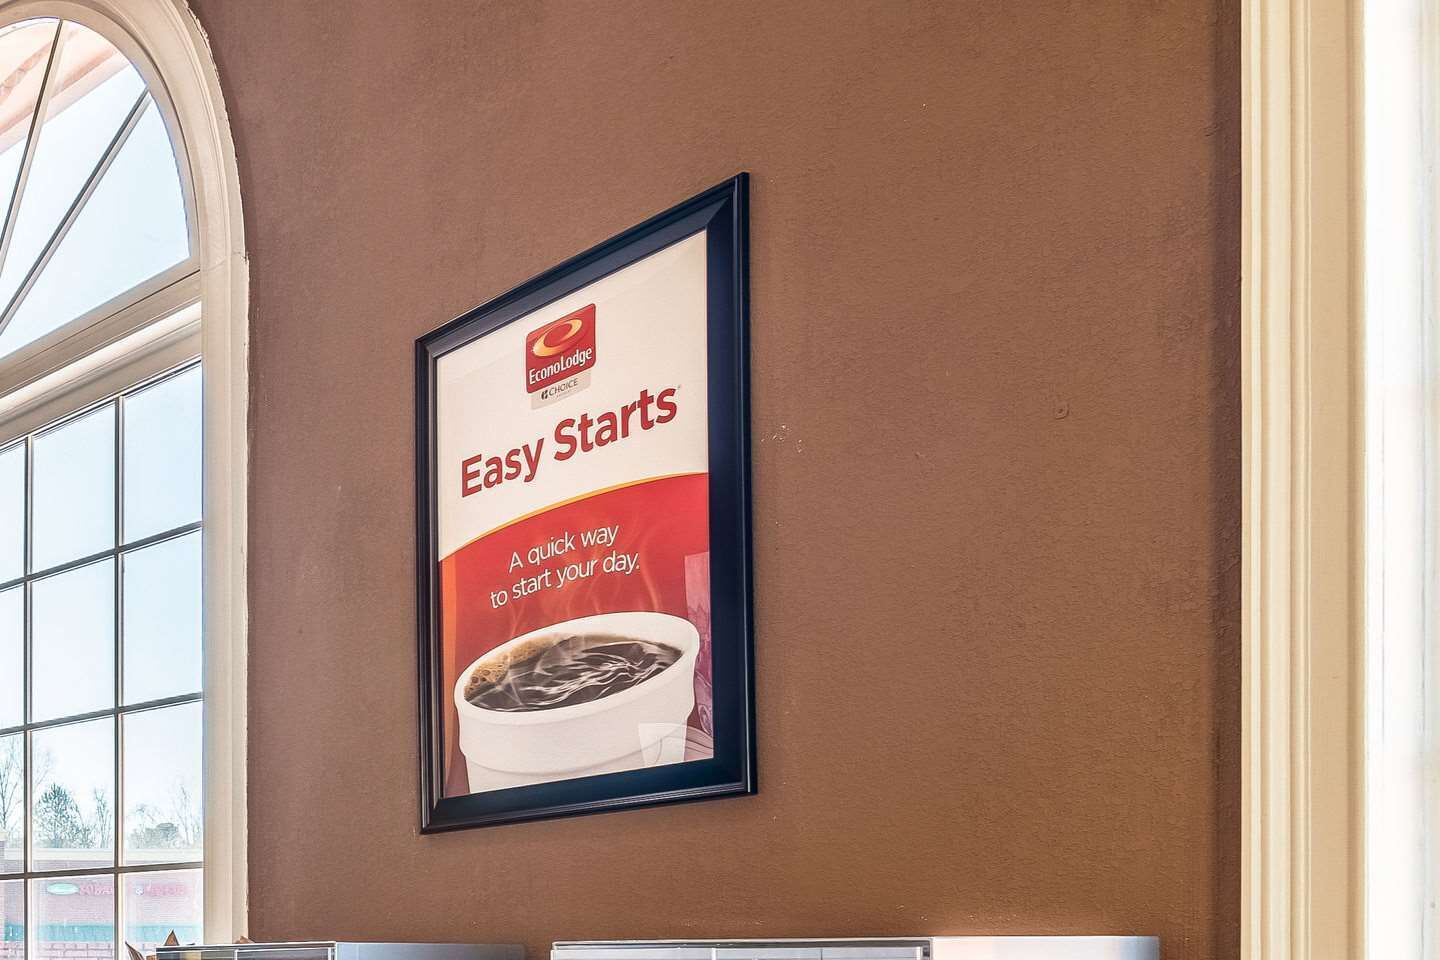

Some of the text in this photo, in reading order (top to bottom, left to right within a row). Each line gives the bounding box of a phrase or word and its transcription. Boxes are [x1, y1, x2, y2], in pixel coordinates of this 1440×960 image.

[529, 348, 593, 385] EconoLodge
[548, 378, 579, 397] CHOICE
[461, 387, 678, 498] Easy Starts
[509, 525, 620, 573] A quick way
[490, 550, 640, 609] to start your day.
